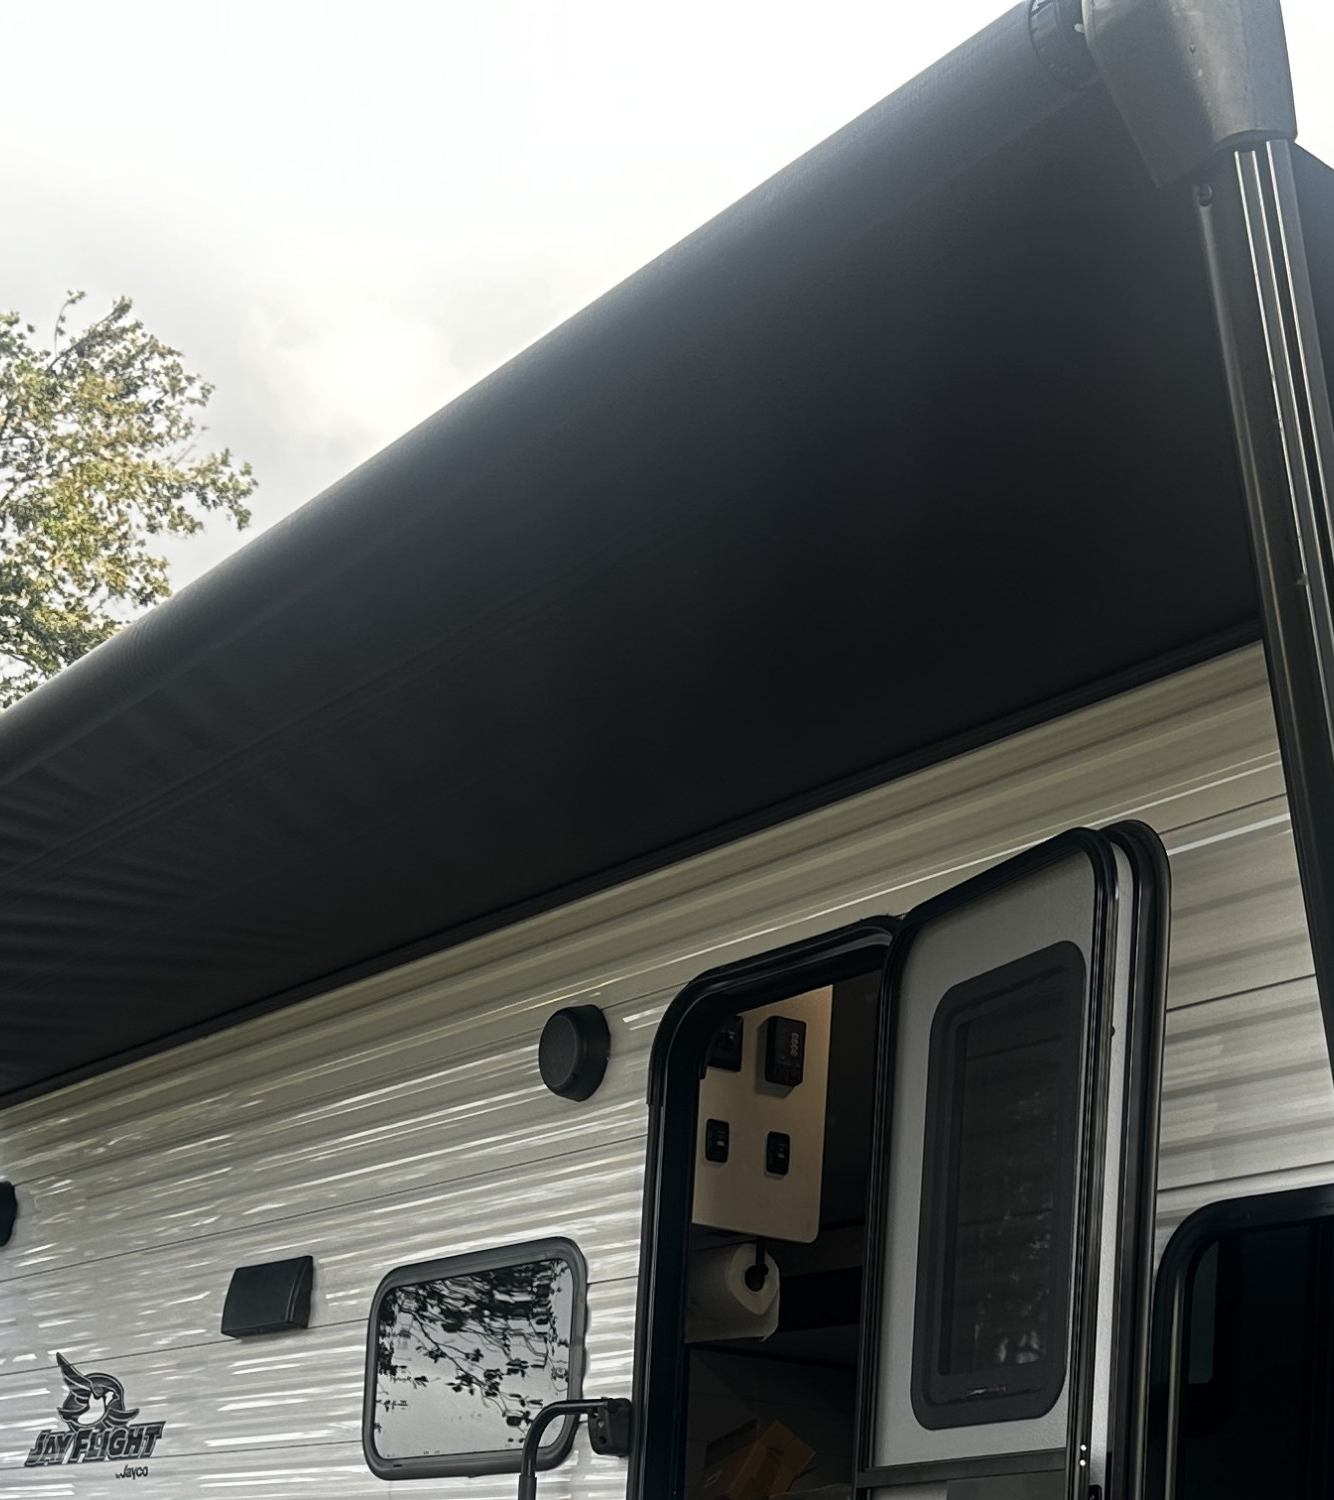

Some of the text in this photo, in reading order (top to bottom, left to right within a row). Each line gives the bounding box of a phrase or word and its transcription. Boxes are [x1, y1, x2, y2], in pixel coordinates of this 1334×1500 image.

[24, 1421, 166, 1467] JAY FLIGHT
[121, 1465, 148, 1480] Jayco
